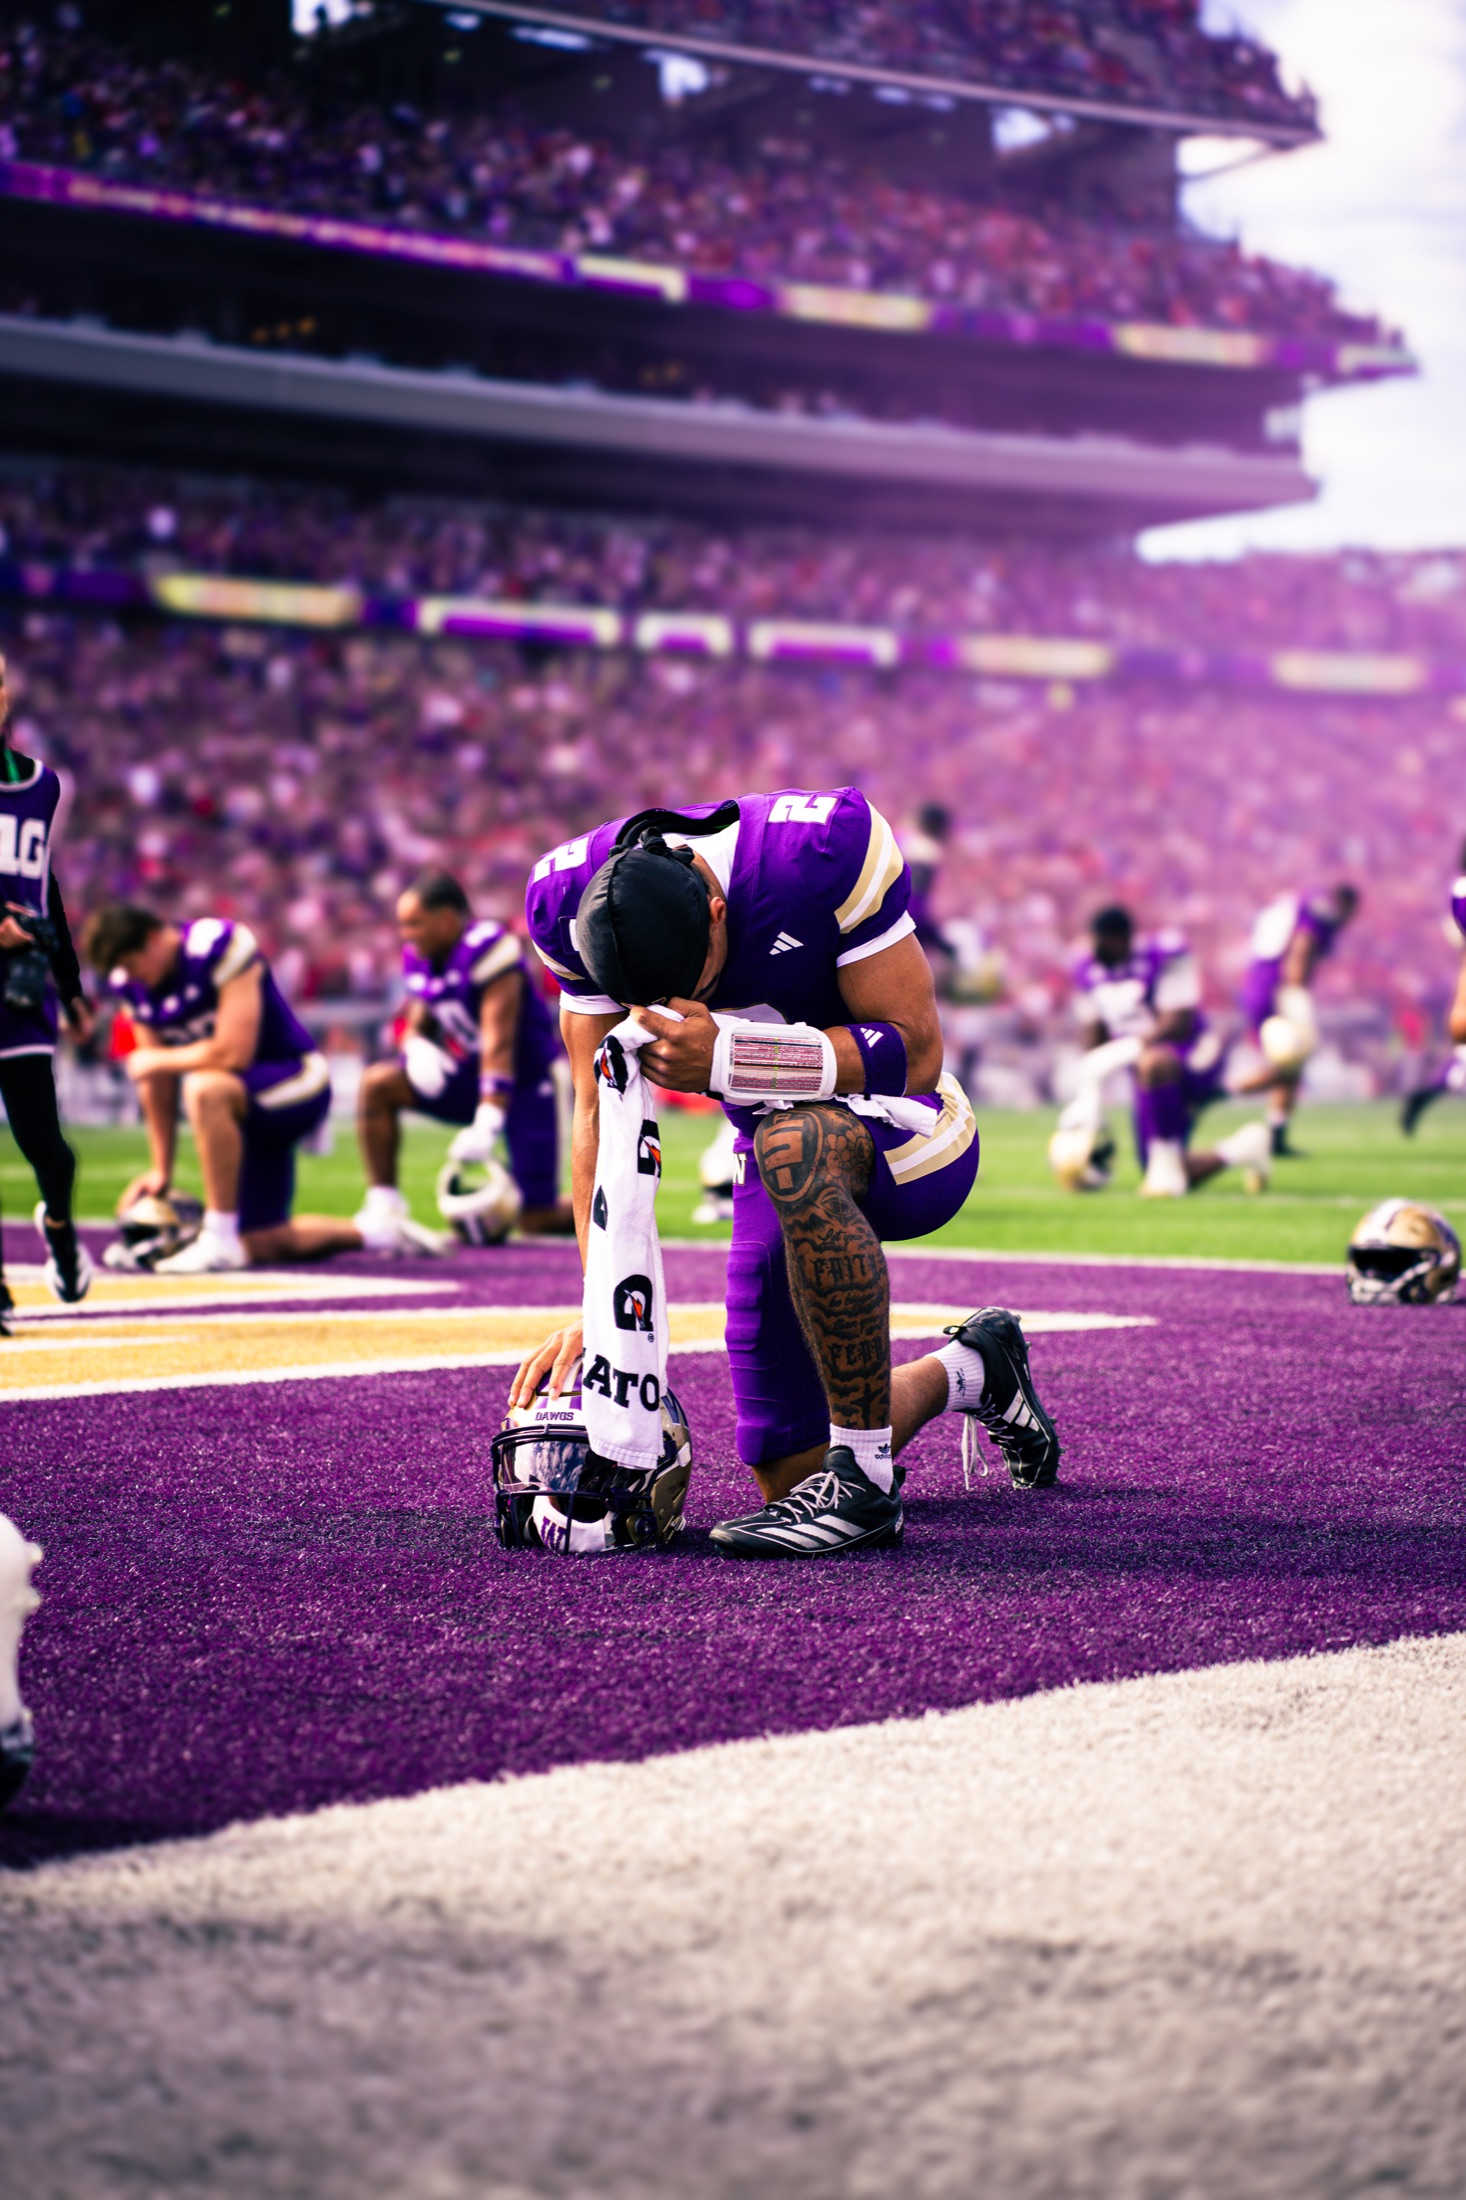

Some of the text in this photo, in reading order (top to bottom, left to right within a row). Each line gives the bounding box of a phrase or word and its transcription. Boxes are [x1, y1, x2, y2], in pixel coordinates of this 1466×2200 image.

[768, 795, 838, 825] 2
[533, 837, 589, 884] 2
[583, 1347, 660, 1412] ATO
[535, 1411, 575, 1421] DAWGS
